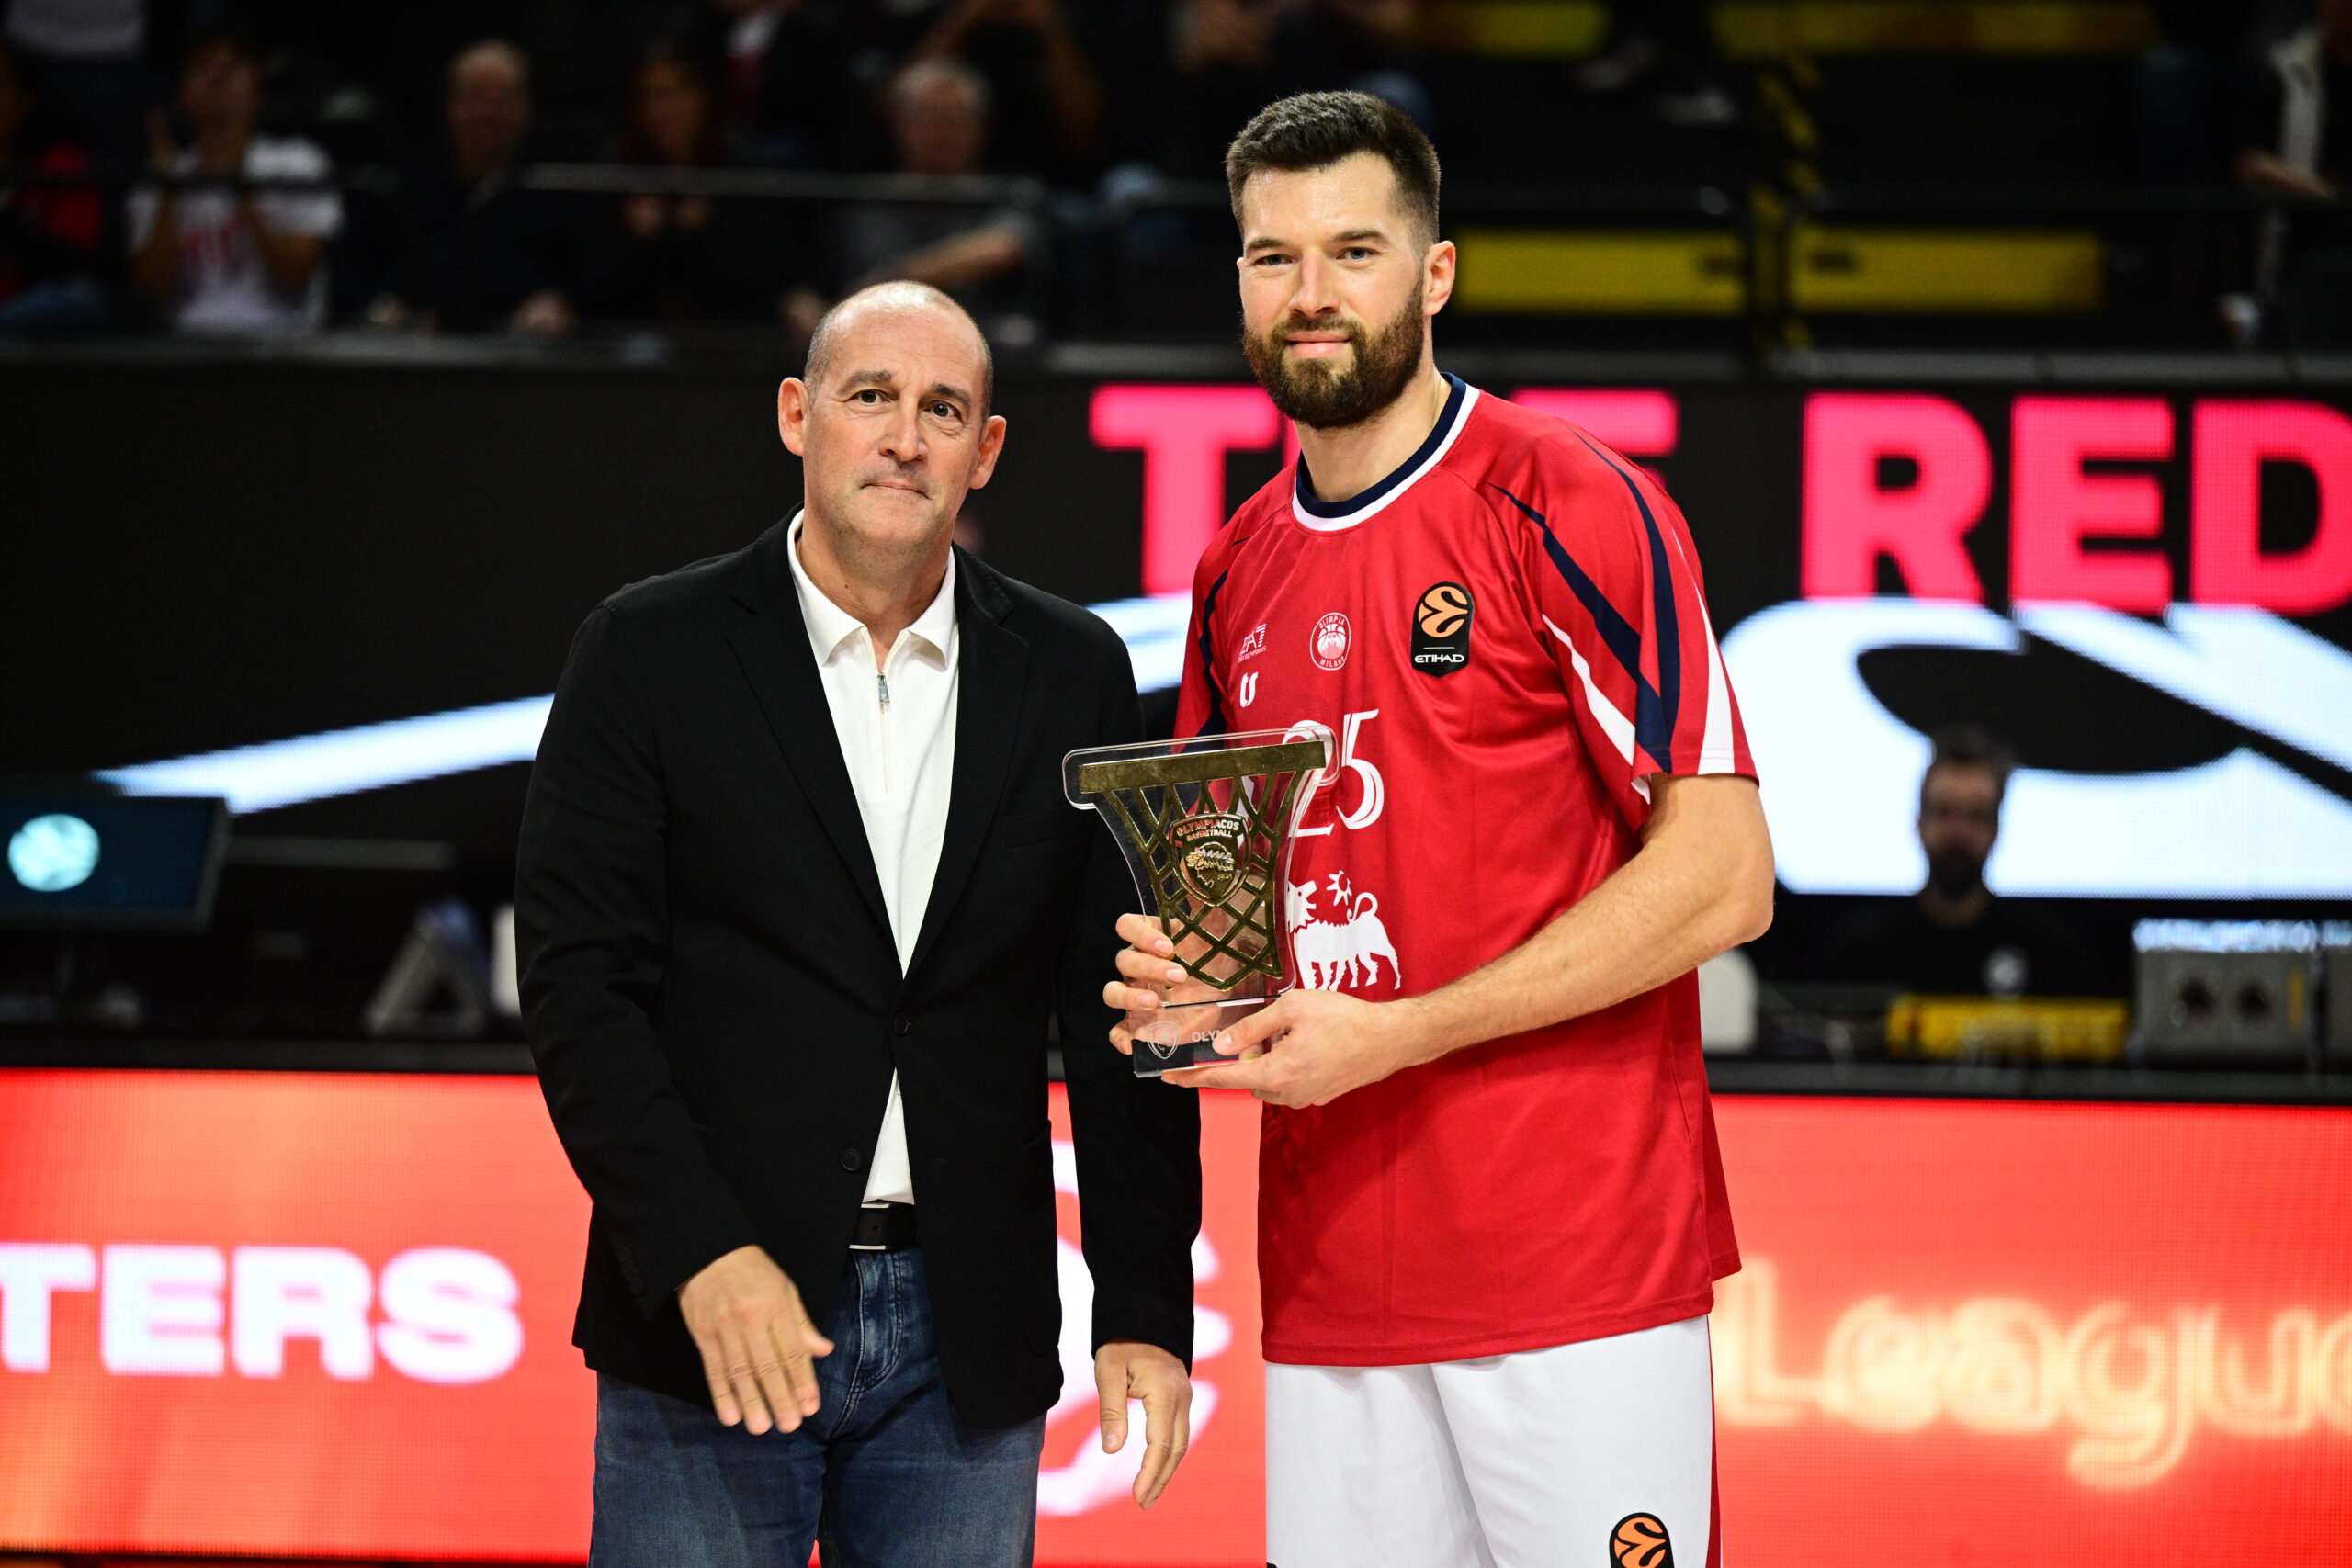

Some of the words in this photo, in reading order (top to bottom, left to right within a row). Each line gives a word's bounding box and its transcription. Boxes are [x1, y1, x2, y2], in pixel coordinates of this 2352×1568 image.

[1801, 392, 2352, 615] RED
[1319, 615, 1345, 629] OLIMPIA
[1239, 624, 1266, 656] EA7
[1319, 656, 1345, 668] MILANO
[1415, 654, 1464, 663] ETIHAD
[1177, 818, 1239, 836] OLYMPIACOS
[1186, 829, 1232, 841] BASKETBALL
[0, 1242, 524, 1383] TERS
